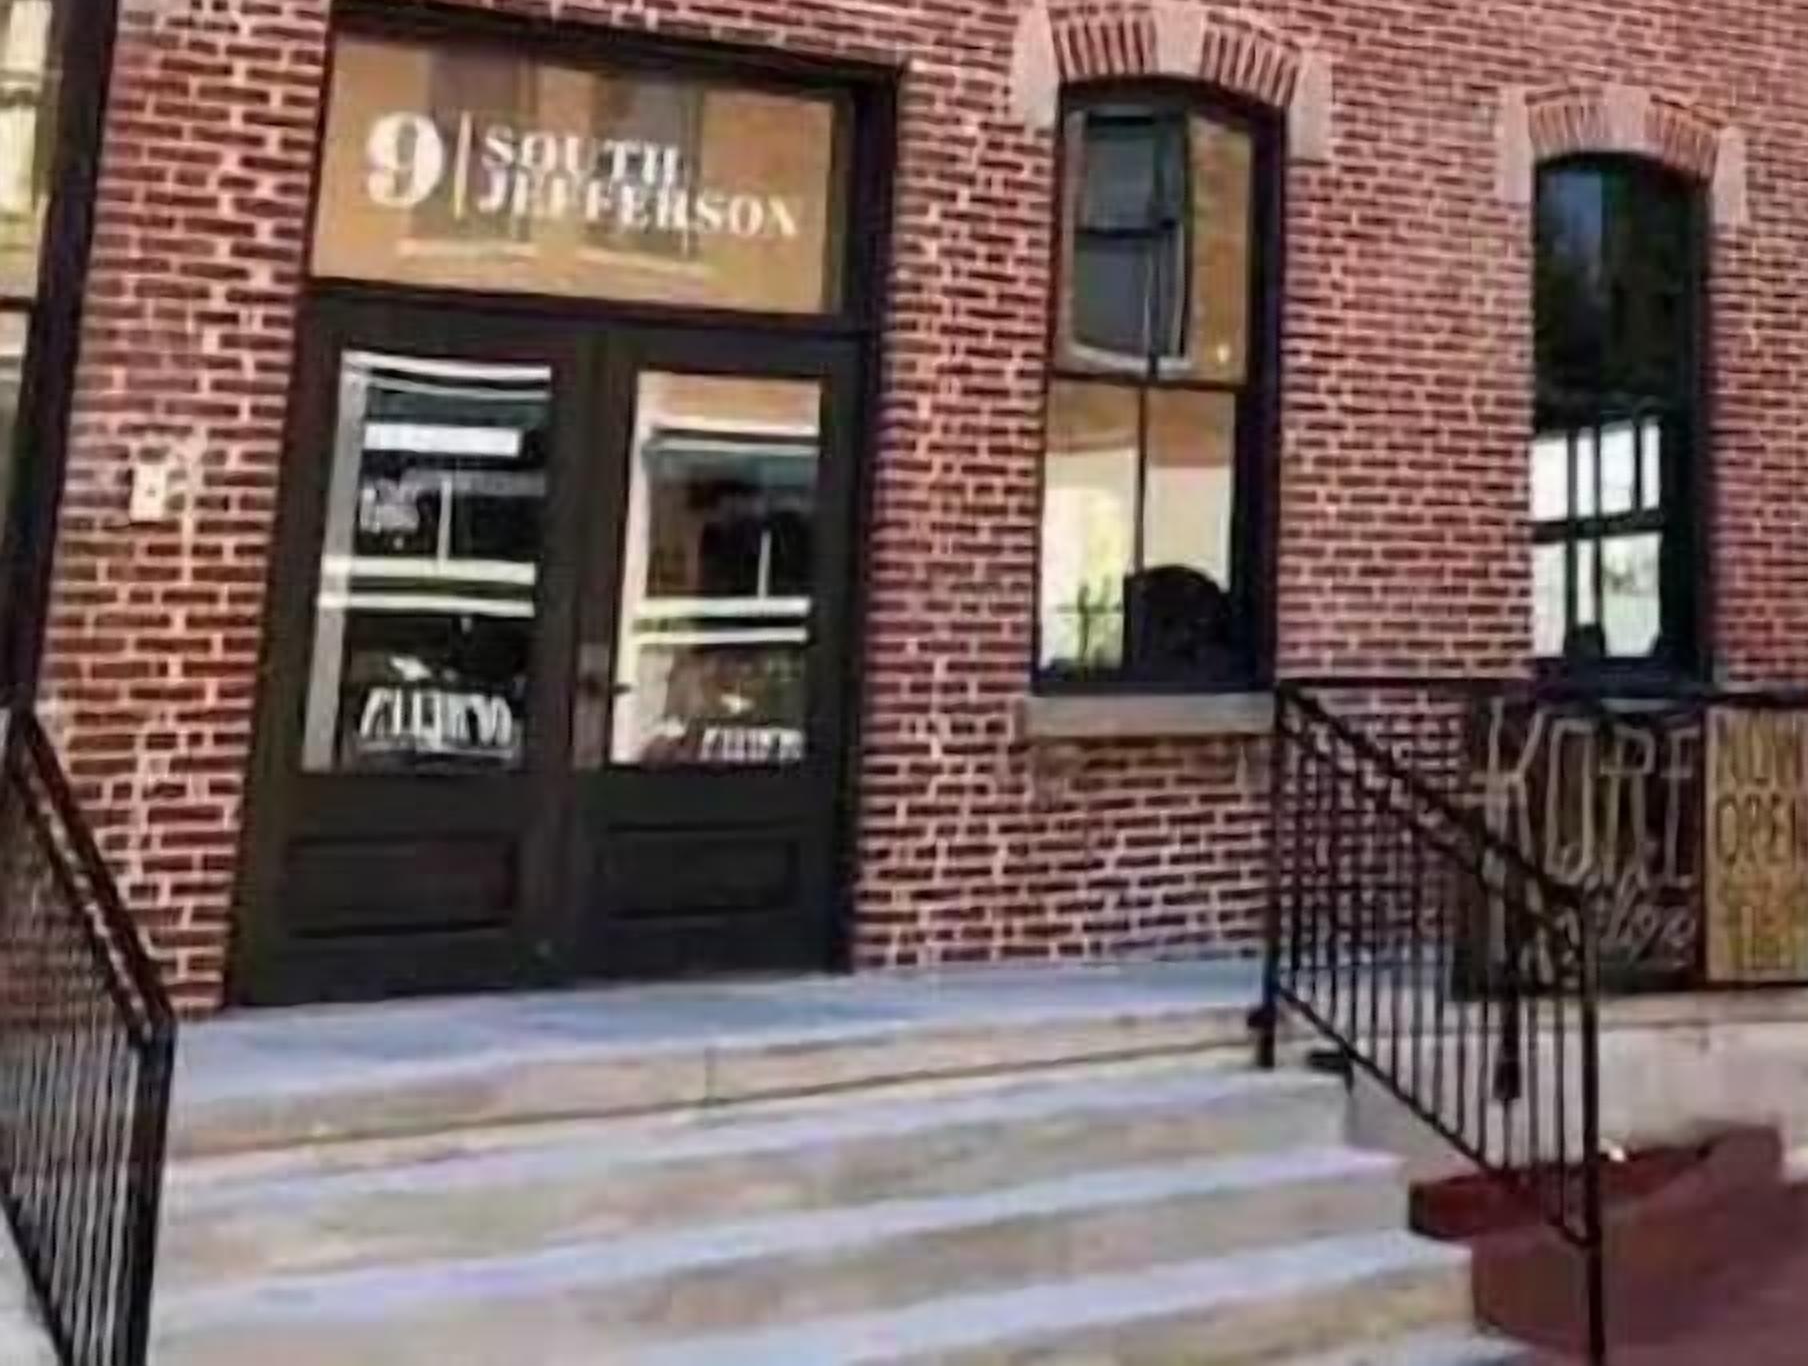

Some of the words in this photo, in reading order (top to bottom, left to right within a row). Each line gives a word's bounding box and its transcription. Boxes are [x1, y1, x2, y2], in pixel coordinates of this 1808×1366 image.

[365, 111, 445, 209] 9
[482, 124, 684, 184] SOUTH
[477, 173, 798, 239] JEFFERSON
